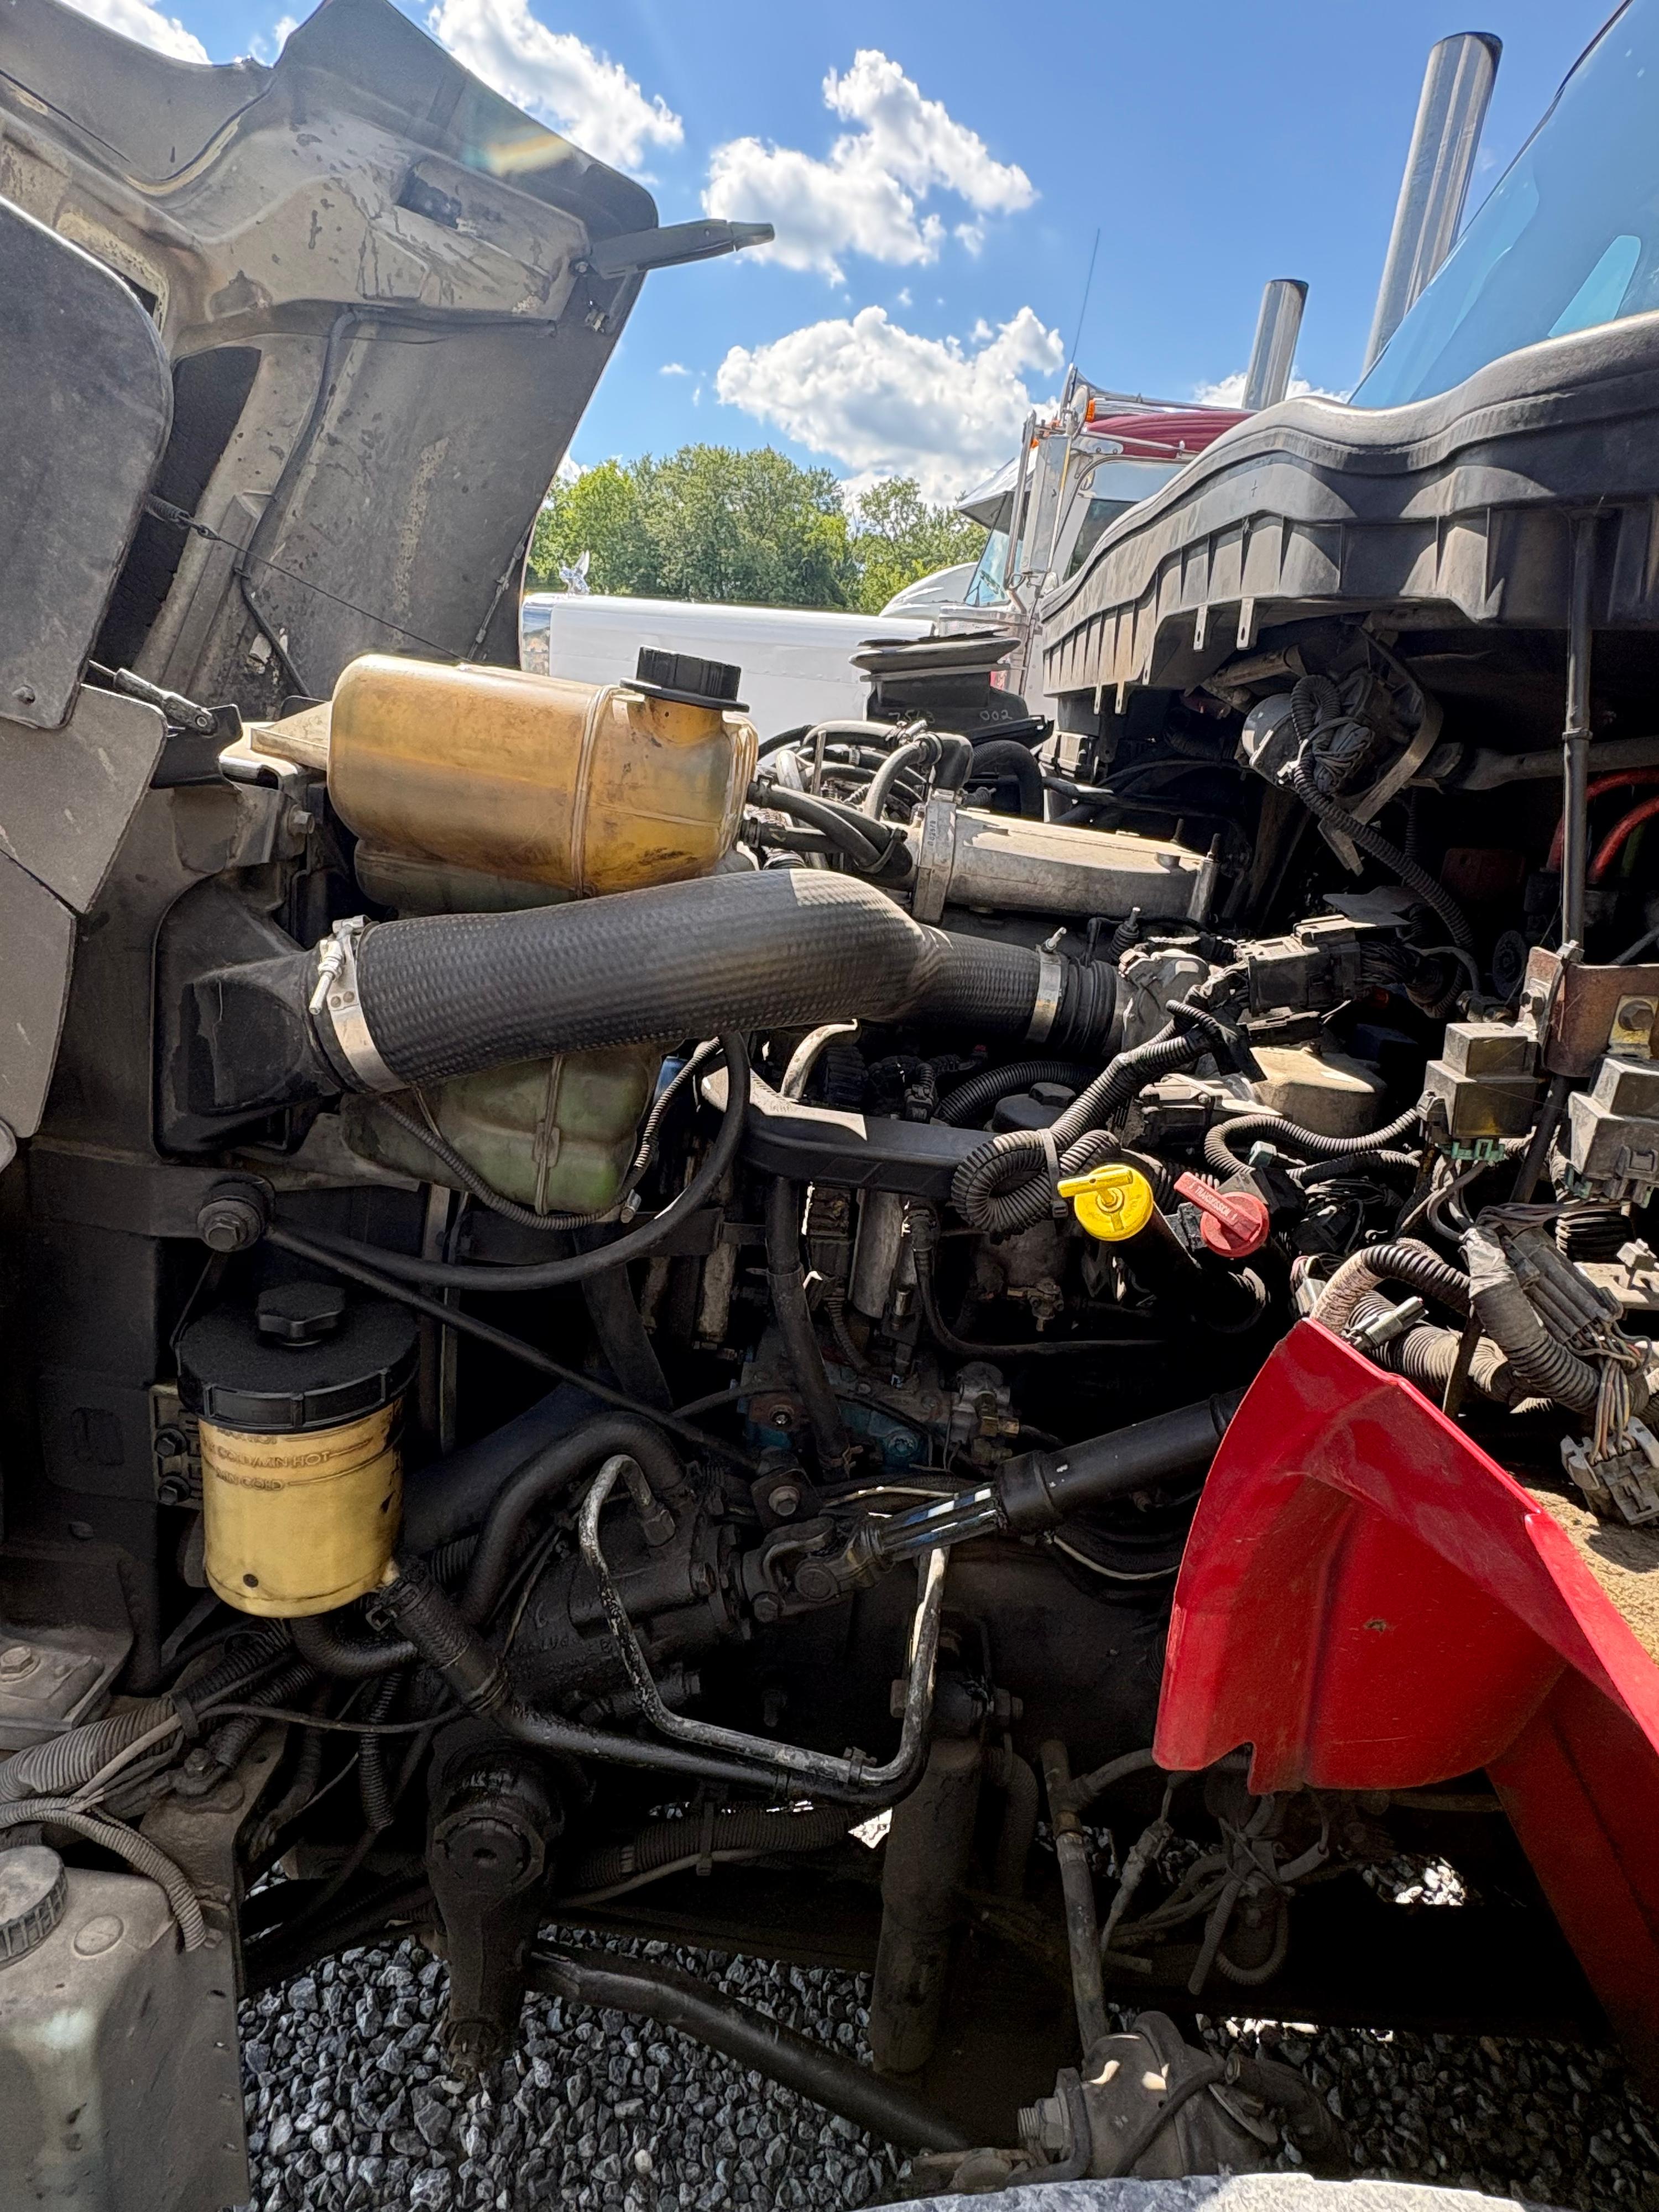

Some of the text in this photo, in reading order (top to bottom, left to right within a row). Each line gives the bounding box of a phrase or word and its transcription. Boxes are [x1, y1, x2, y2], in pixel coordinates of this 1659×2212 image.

[979, 709, 1013, 721] 002
[1194, 1185, 1232, 1217] TRANSMISSION
[292, 1451, 330, 1468] HOT
[240, 1475, 285, 1491] COLD
